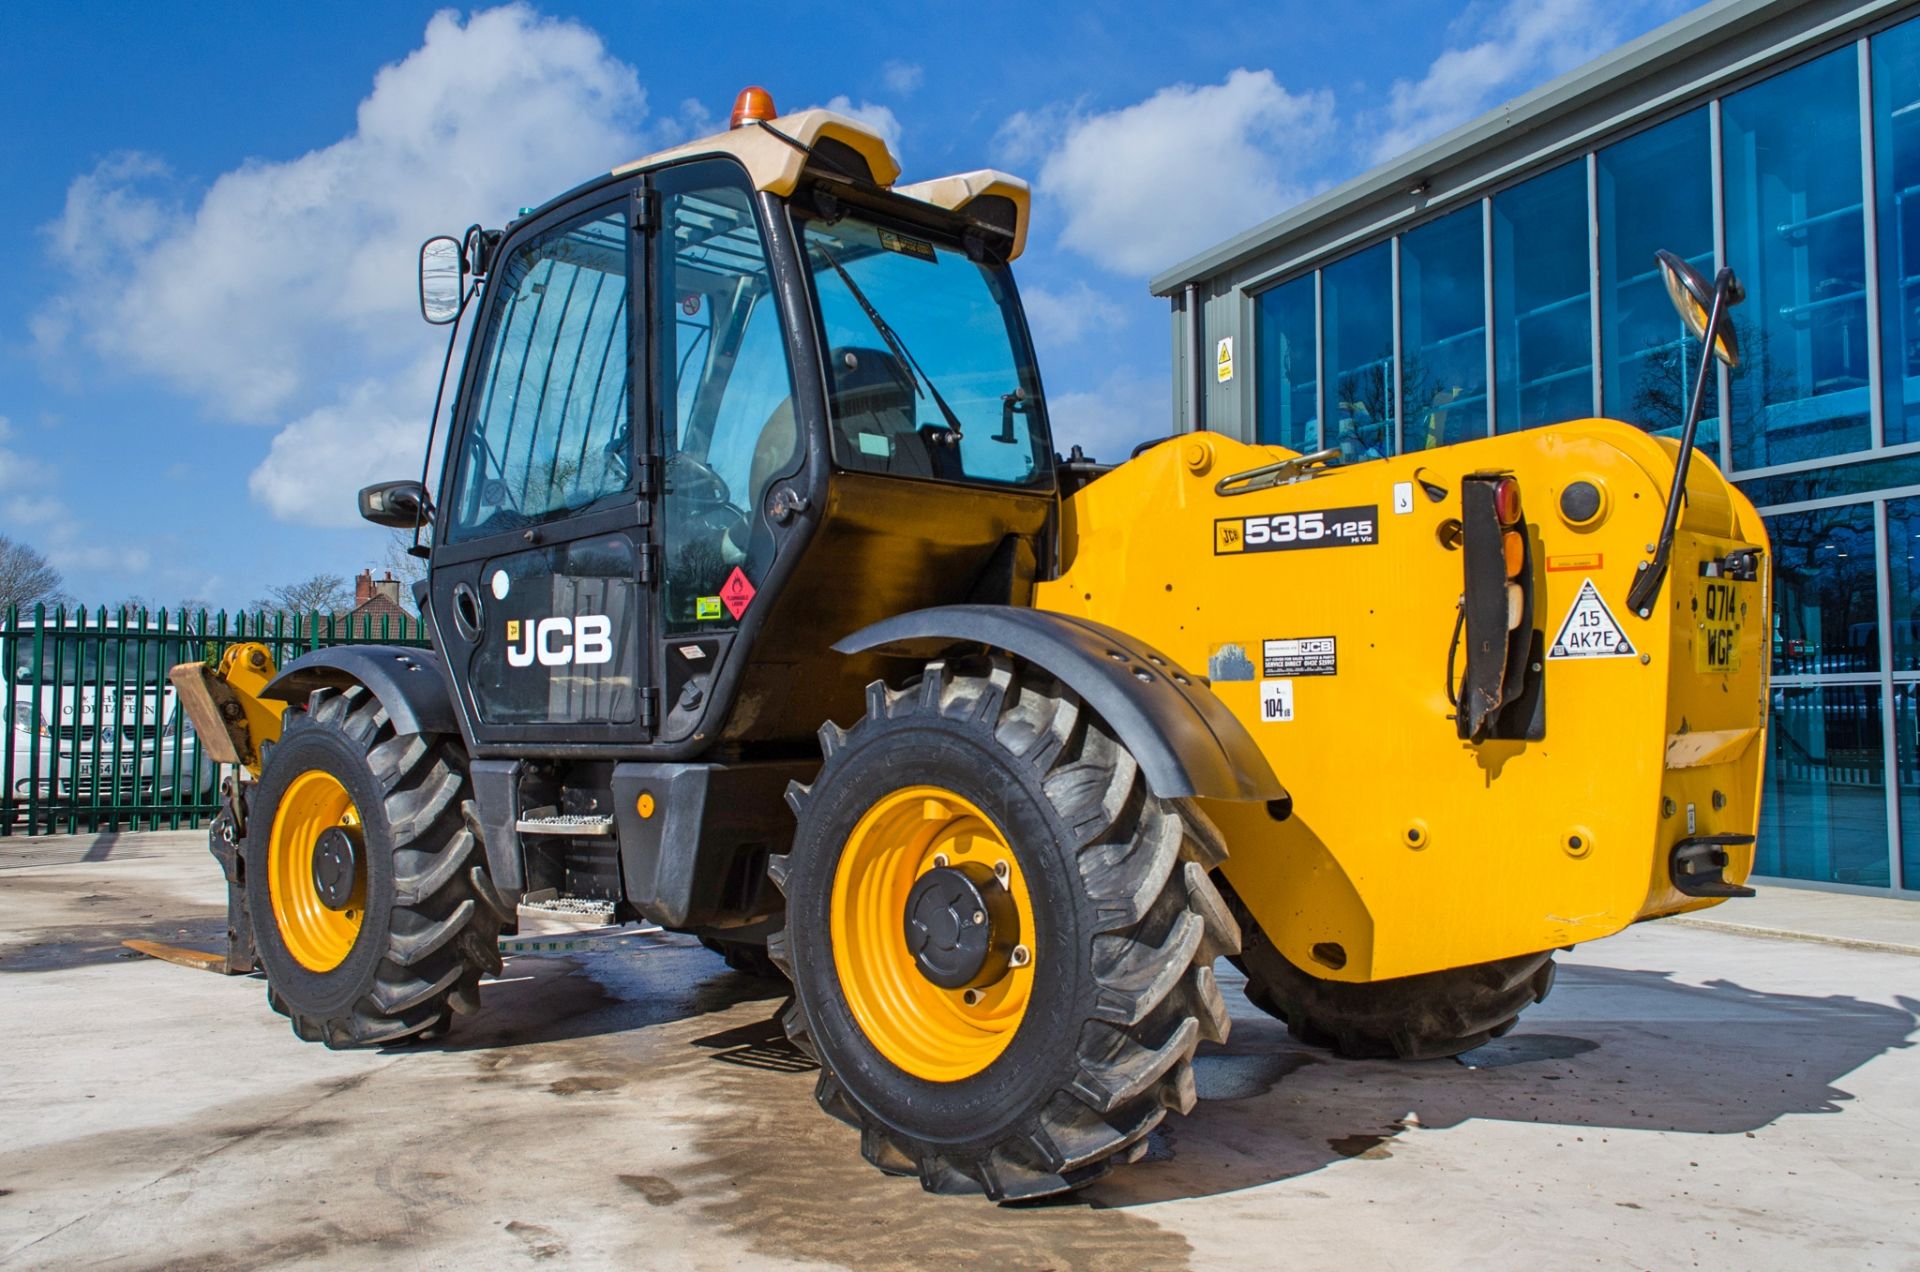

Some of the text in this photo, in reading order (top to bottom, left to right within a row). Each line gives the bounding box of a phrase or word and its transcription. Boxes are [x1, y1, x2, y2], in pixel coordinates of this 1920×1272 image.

[1245, 513, 1372, 544] 535-125
[1706, 584, 1735, 621] Q714
[1580, 611, 1600, 627] 15
[506, 615, 612, 667] JCB
[1301, 641, 1332, 653] JCB
[1570, 631, 1614, 648] AK7E
[1264, 698, 1283, 718] 104
